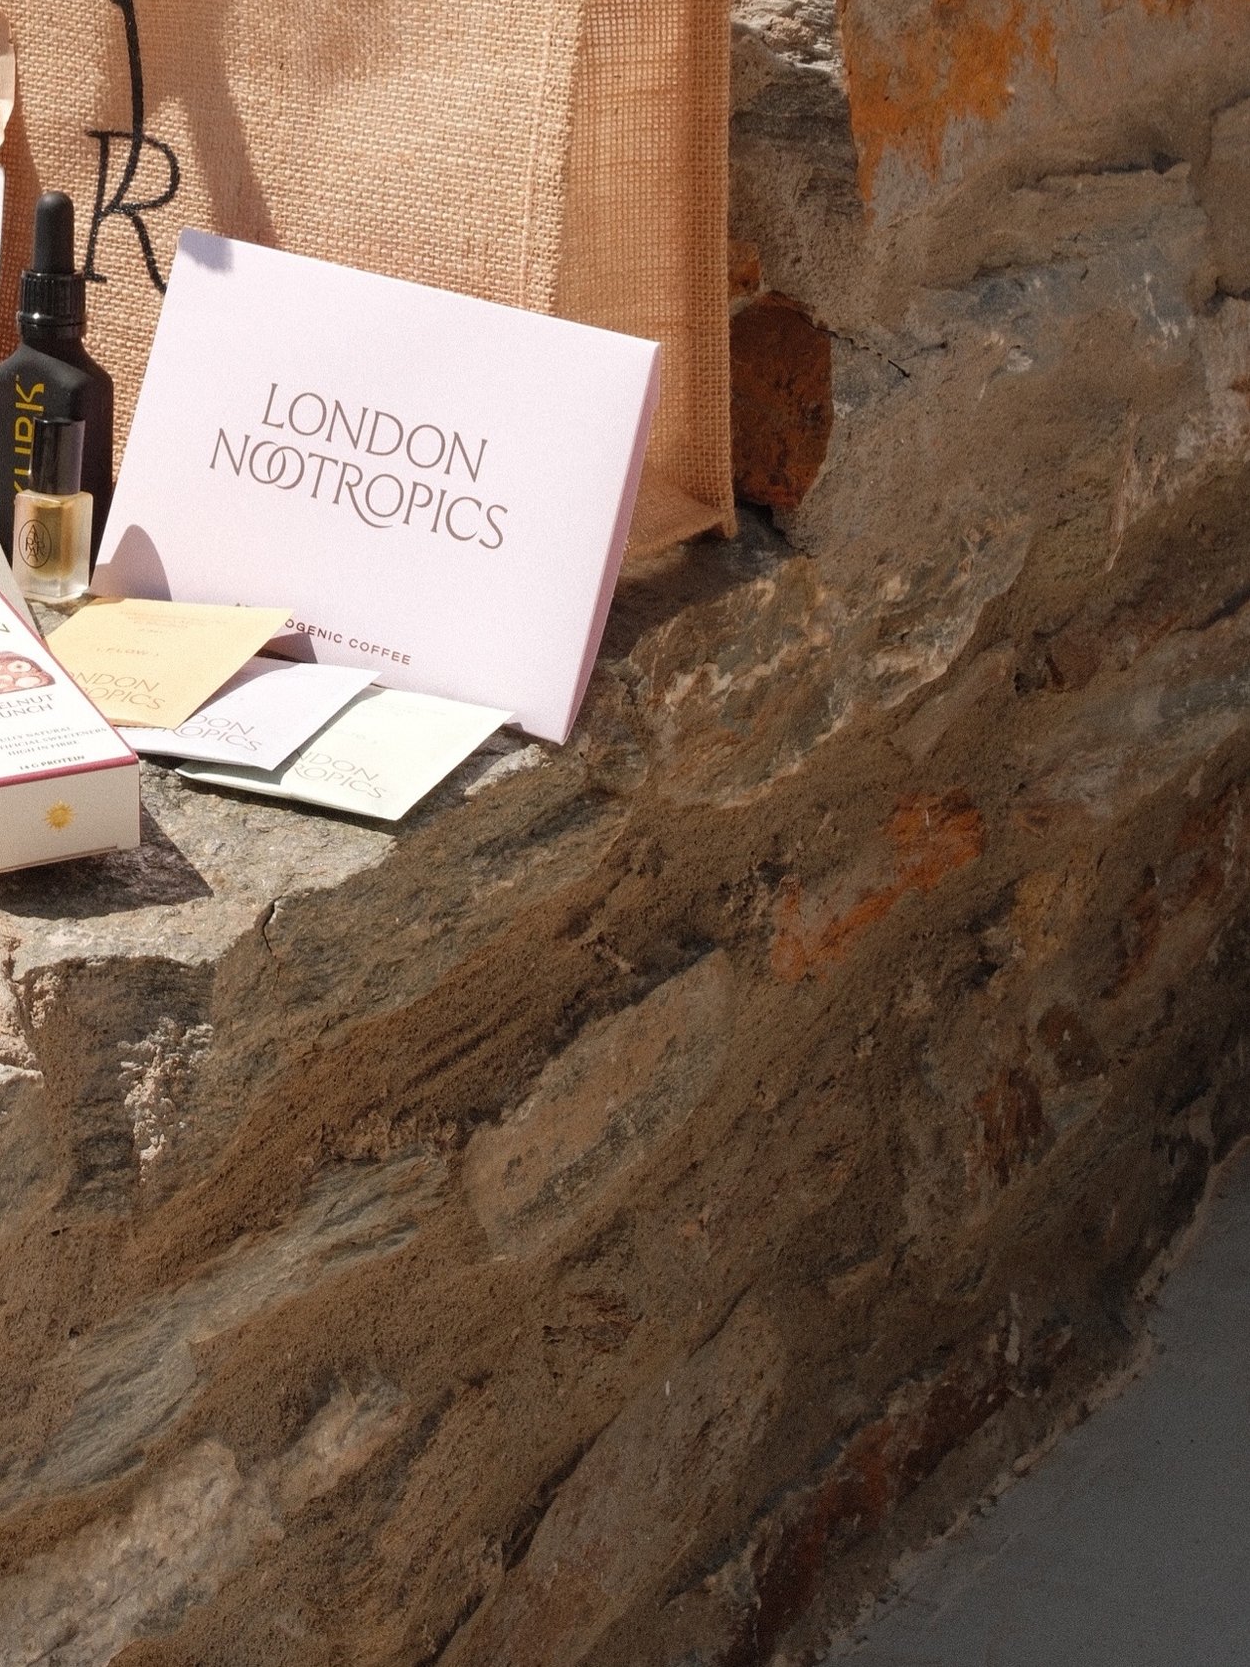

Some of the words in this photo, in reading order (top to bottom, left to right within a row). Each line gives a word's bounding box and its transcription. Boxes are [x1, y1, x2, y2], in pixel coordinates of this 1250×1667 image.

[261, 382, 488, 483] LONDON
[208, 427, 509, 550] NOOTROPICS
[284, 618, 343, 644] OGENIC
[349, 638, 412, 666] COFFEE
[70, 672, 160, 692] NDON
[26, 726, 72, 738] NATURAL
[189, 714, 255, 735] DON
[41, 755, 85, 767] PROTEIN
[296, 751, 380, 782] NDON
